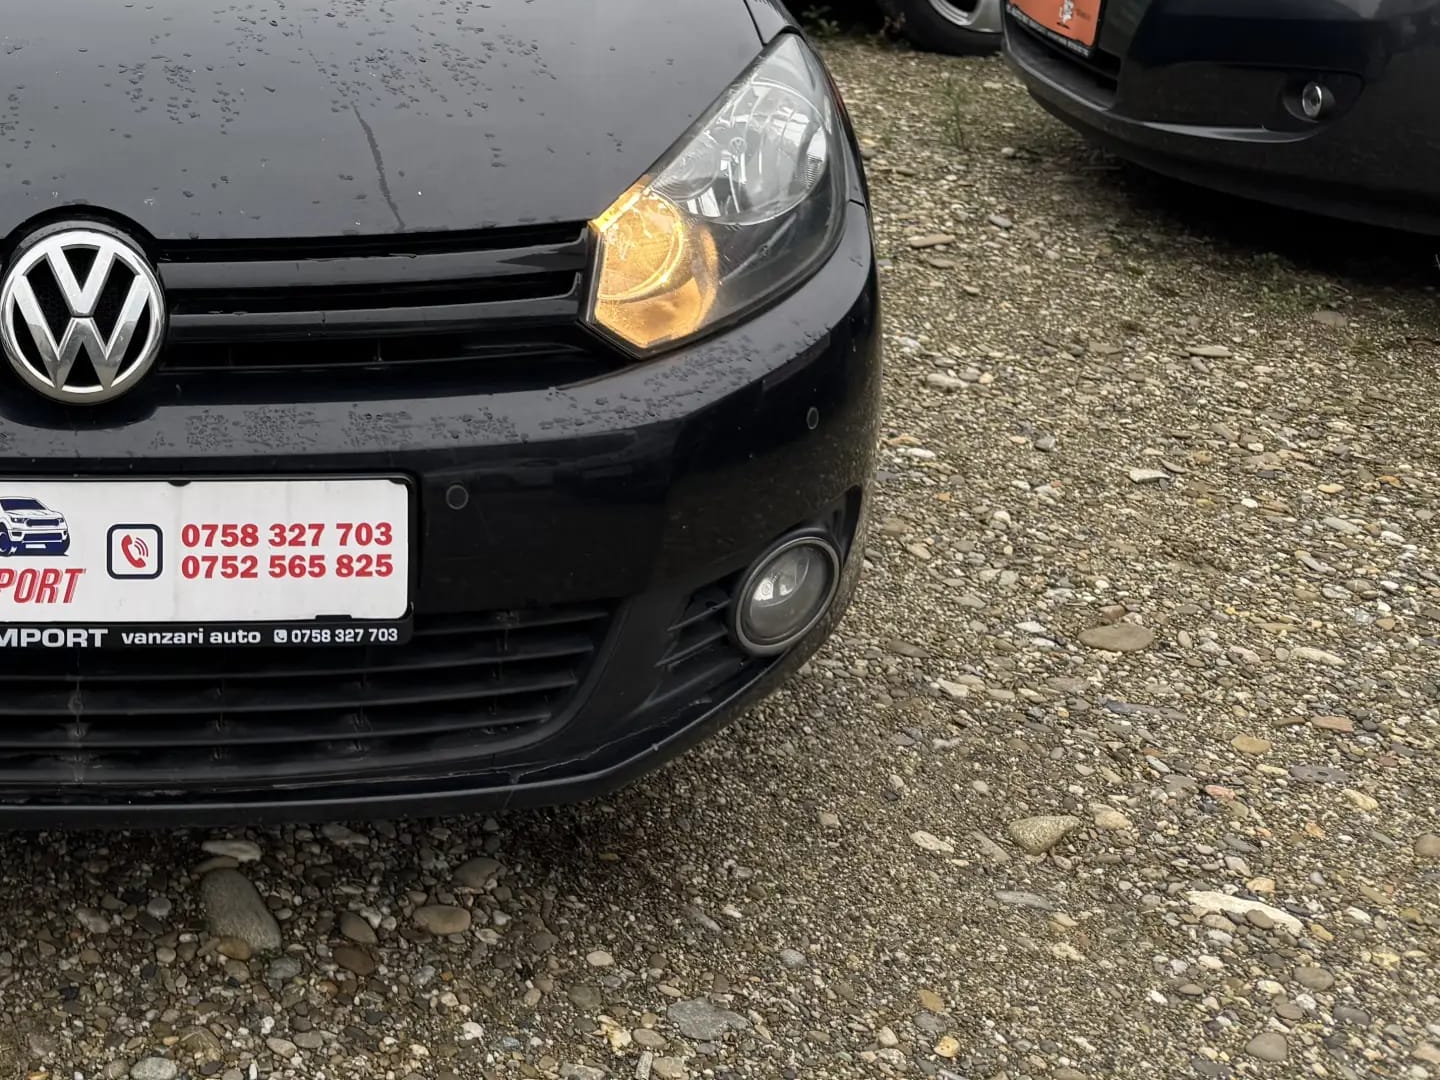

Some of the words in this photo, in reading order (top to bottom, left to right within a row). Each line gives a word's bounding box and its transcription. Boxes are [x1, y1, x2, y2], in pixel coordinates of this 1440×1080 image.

[1, 231, 163, 401] VW
[181, 523, 259, 547] 0758
[268, 523, 325, 547] 327
[335, 522, 393, 546] 703
[181, 555, 258, 579] 0752
[268, 554, 326, 578] 565
[335, 553, 393, 577] 825
[121, 628, 203, 645] vanzari
[210, 629, 261, 645] auto
[291, 629, 331, 643] 0758
[335, 628, 364, 643] 327
[369, 627, 398, 642] 703
